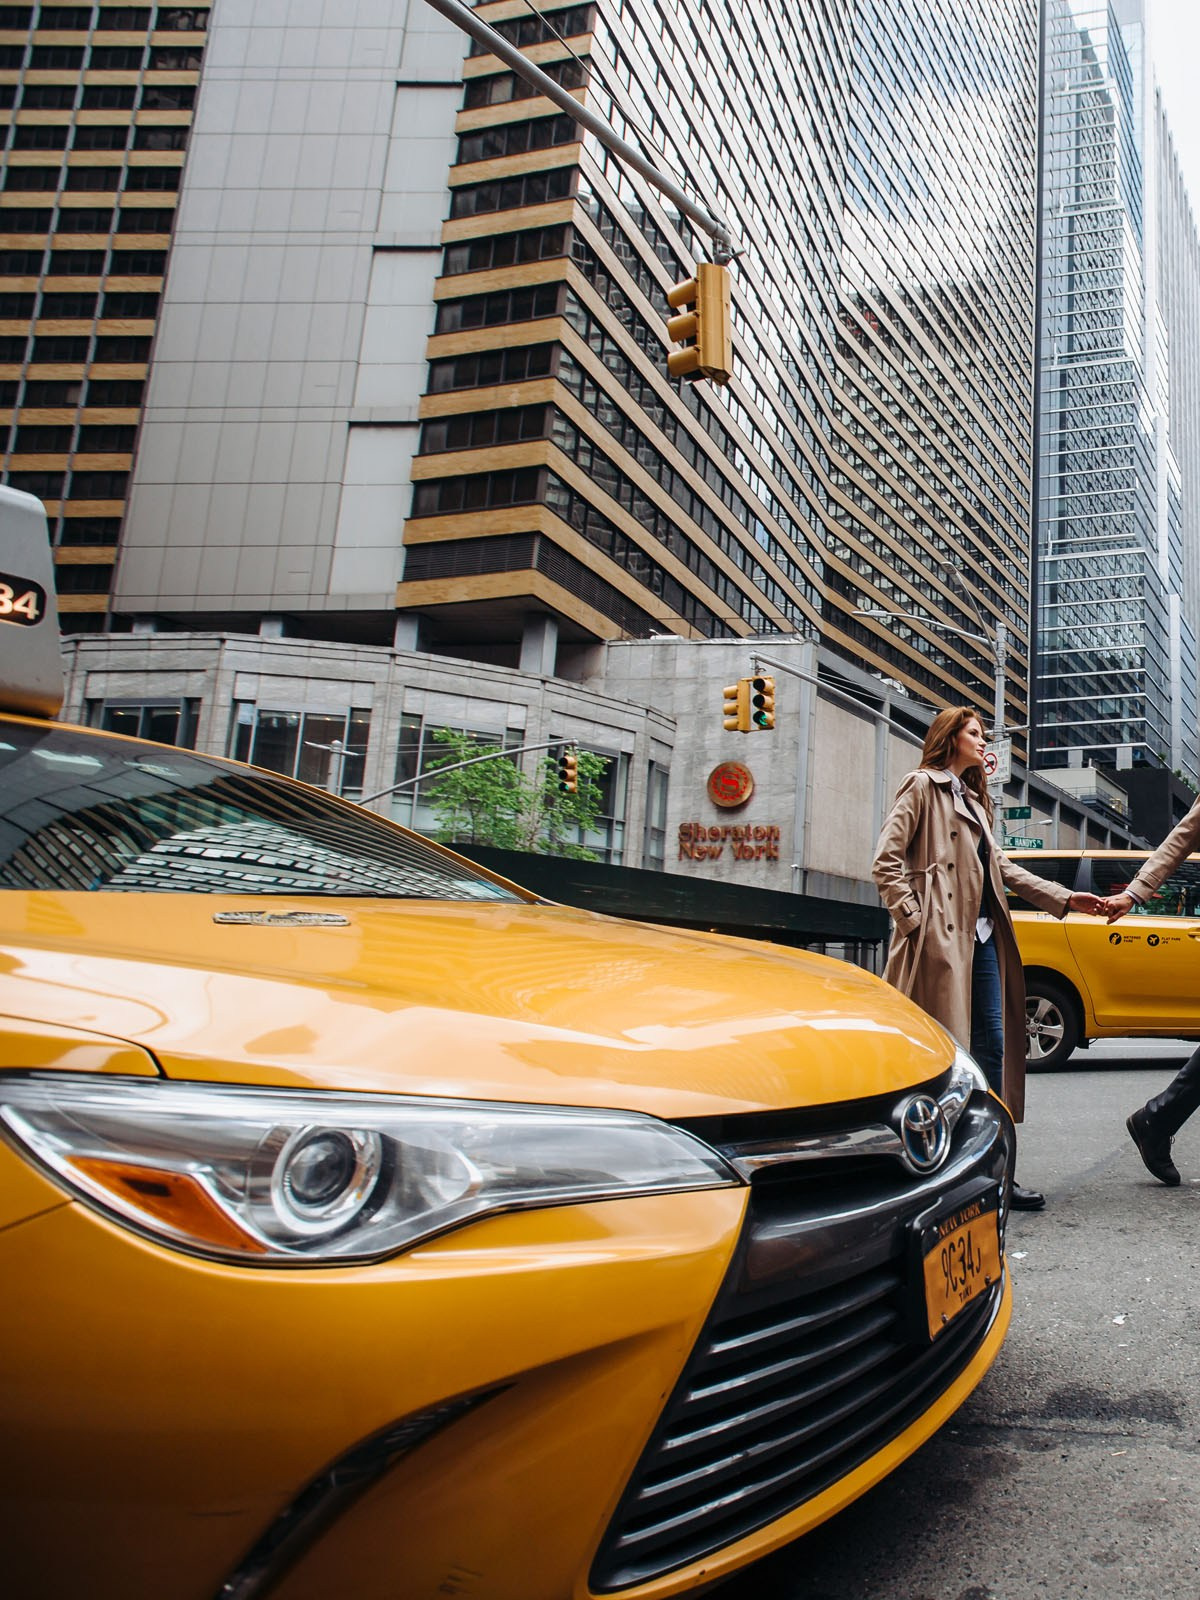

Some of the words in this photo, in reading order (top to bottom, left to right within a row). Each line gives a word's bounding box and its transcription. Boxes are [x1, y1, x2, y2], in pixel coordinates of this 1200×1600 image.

[1015, 808, 1021, 817] 7
[678, 822, 780, 842] Sheraton
[677, 841, 723, 862] New
[731, 841, 779, 861] York
[938, 1215, 958, 1239] NEW
[960, 1202, 981, 1223] YORK
[941, 1230, 981, 1299] 9C34J
[958, 1285, 972, 1303] TAXI
